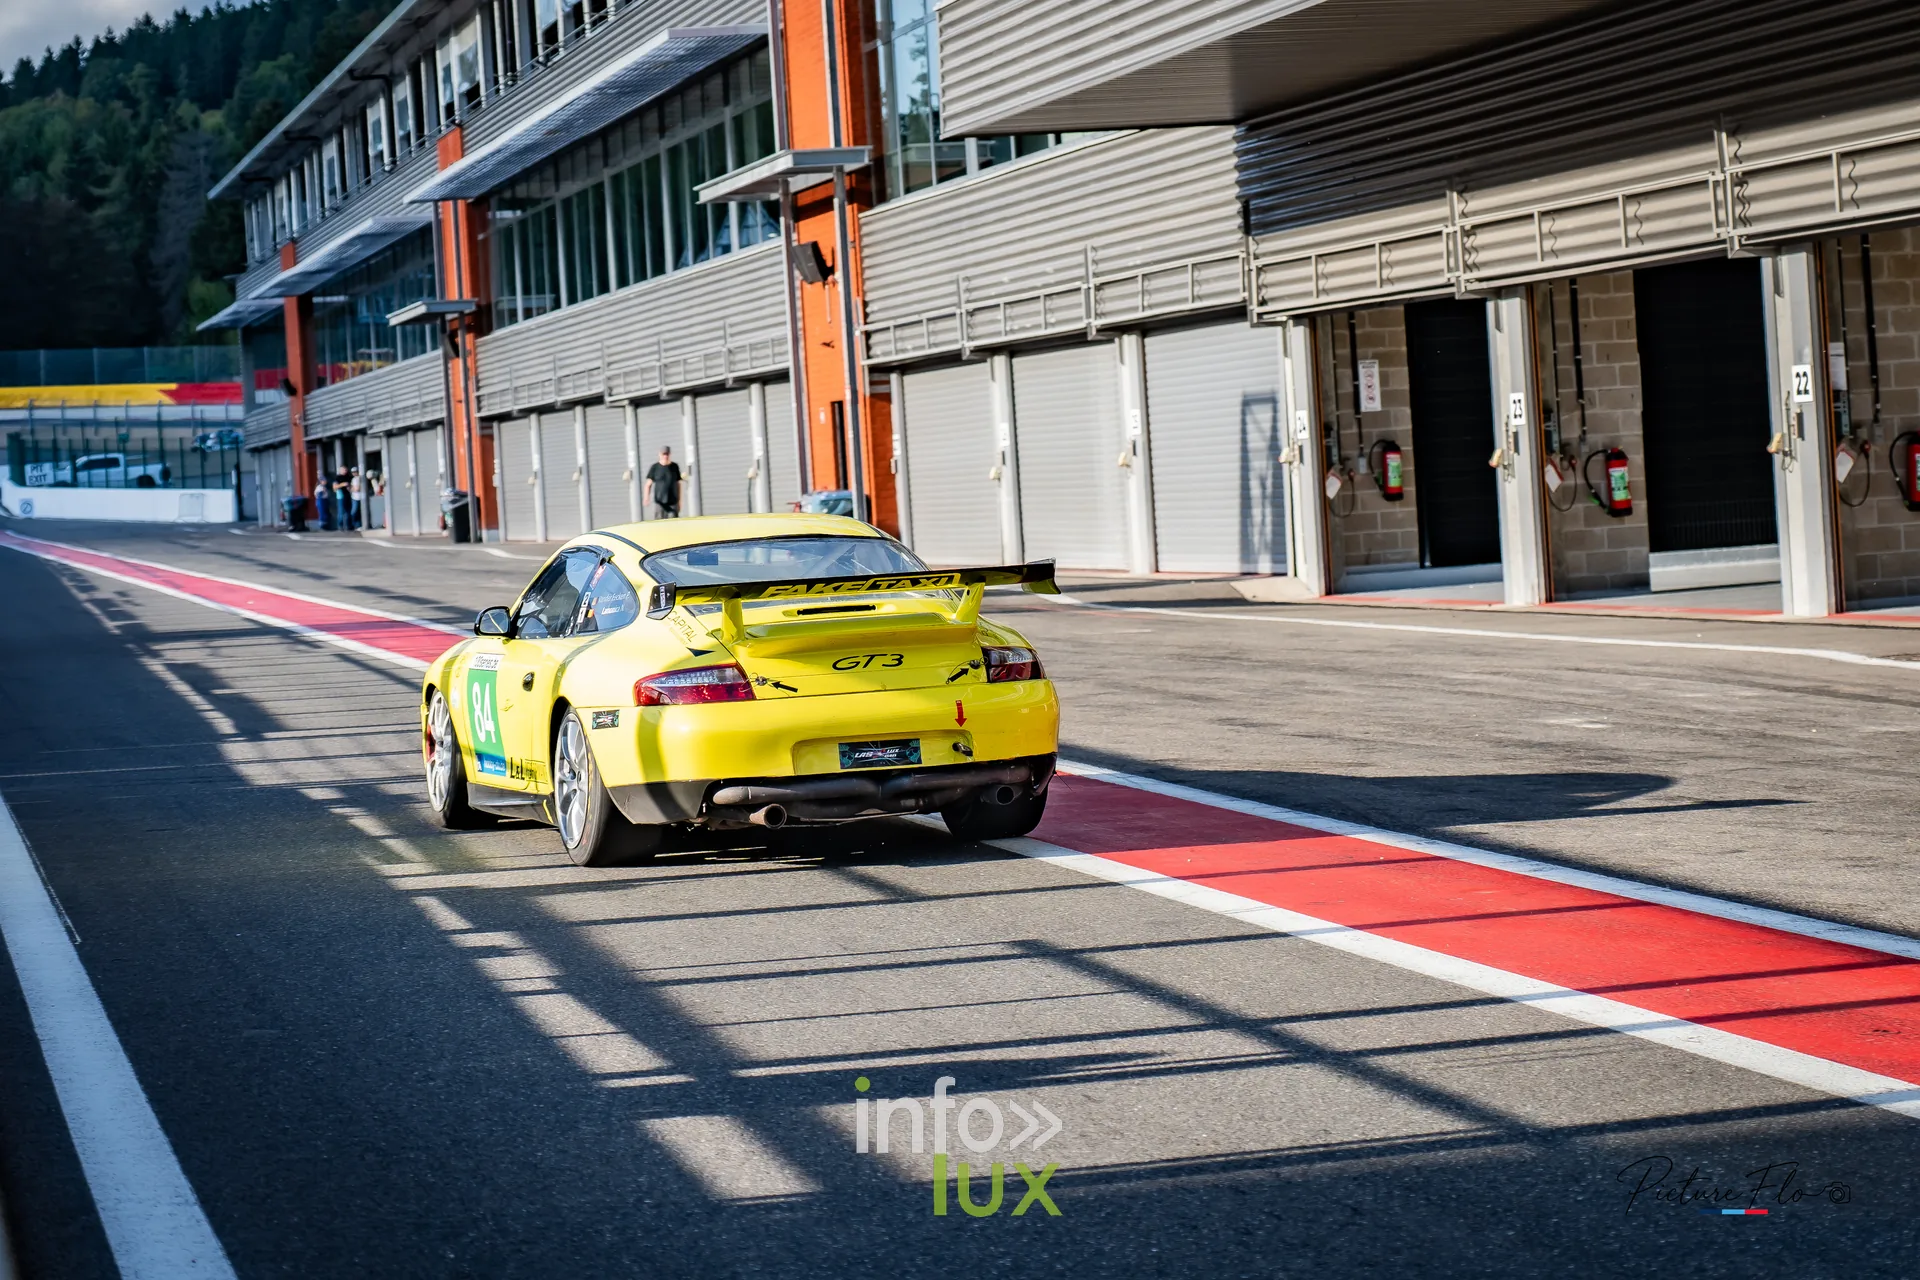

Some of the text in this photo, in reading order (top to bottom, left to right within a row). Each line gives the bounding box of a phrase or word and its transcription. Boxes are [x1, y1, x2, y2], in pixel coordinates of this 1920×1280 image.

[1795, 371, 1810, 396] 22
[1512, 398, 1523, 419] 23
[28, 474, 47, 485] EXIT
[30, 464, 44, 474] PIT
[759, 575, 949, 598] FAKE TAXI
[667, 610, 697, 643] CAPITAL
[832, 653, 904, 671] GT3
[472, 681, 497, 744] 84
